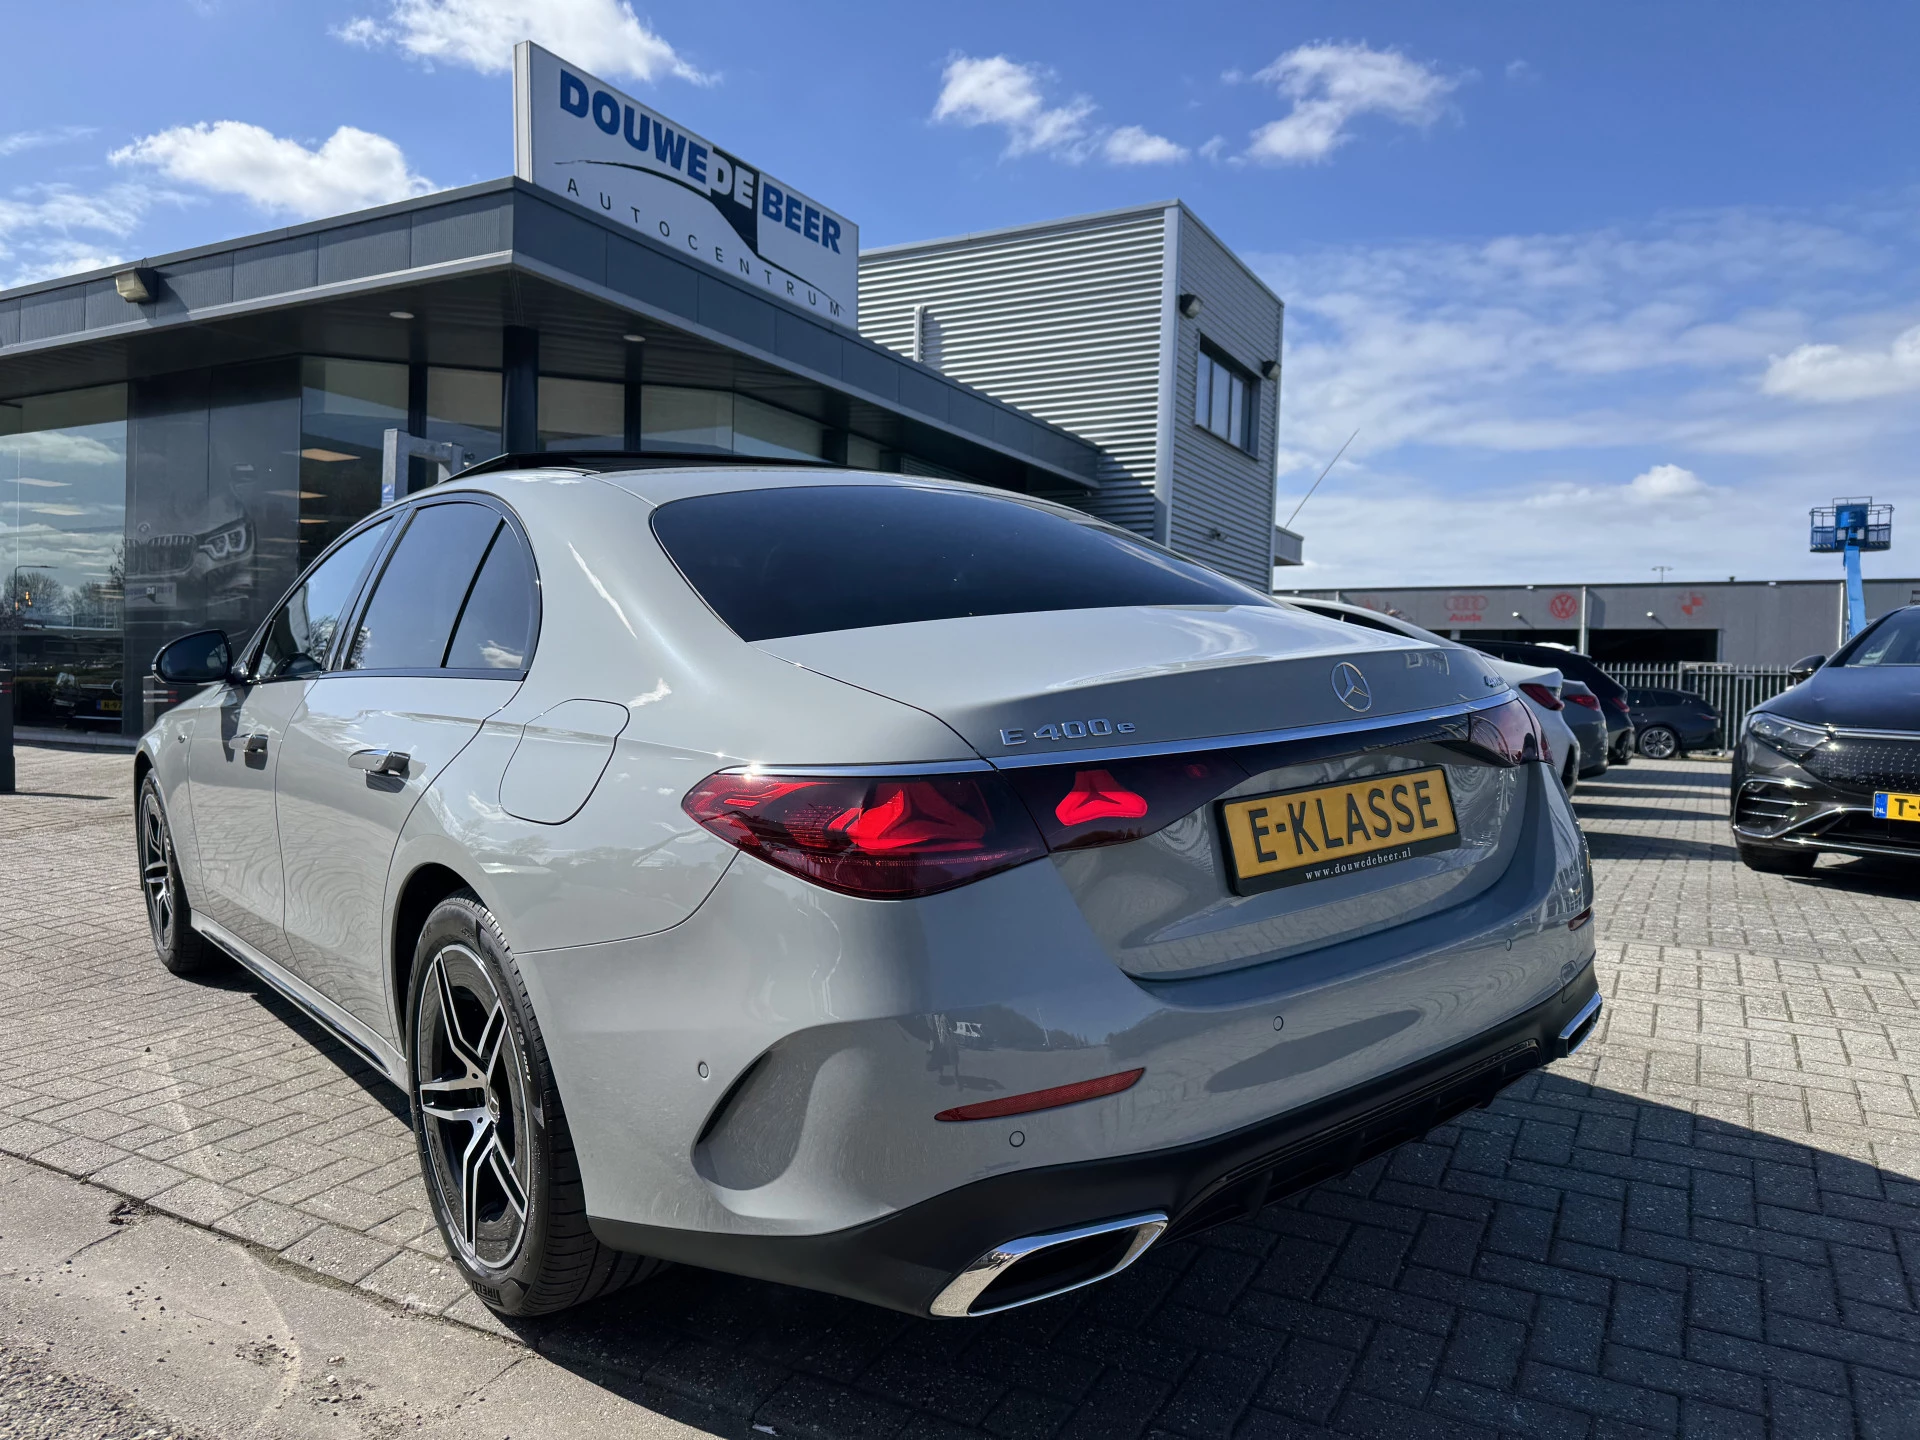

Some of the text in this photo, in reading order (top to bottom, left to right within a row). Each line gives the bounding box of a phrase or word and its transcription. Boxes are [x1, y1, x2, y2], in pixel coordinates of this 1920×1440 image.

[560, 68, 841, 255] DOUWE DE BEER
[567, 178, 841, 317] AUTOCENTRUM
[1000, 728, 1027, 746] E
[1248, 779, 1438, 864] E-KLASSE
[1894, 797, 1920, 818] T-
[1305, 847, 1412, 880] www.douwedebeer.nl
